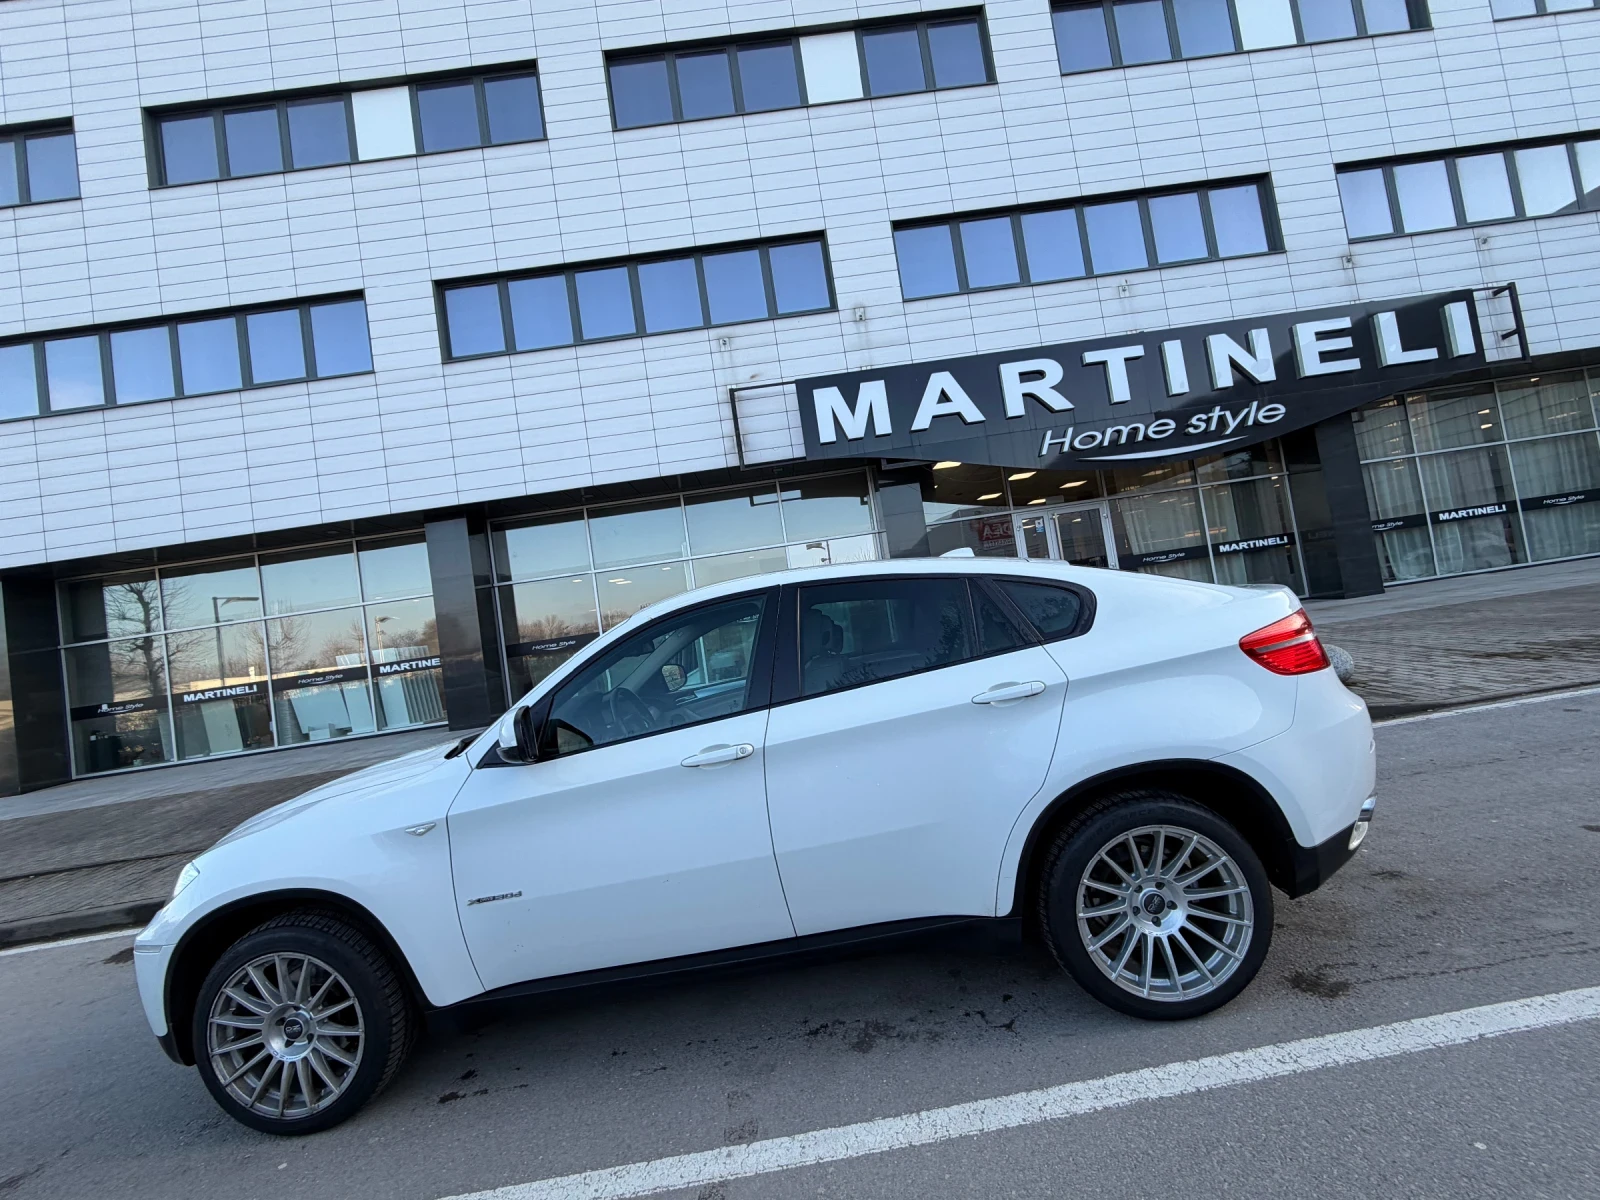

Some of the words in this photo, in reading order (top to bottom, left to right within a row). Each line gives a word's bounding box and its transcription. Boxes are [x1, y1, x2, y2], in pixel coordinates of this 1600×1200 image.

[812, 299, 1477, 444] MARTINELI
[1038, 416, 1176, 457] Home
[1184, 400, 1286, 437] style
[1438, 503, 1507, 521] MARTINELI
[1219, 535, 1288, 553] MARTINELI
[1142, 555, 1167, 563] Home
[532, 642, 557, 650] Home
[379, 657, 441, 674] MARTINE
[183, 684, 258, 703] MARTINELI
